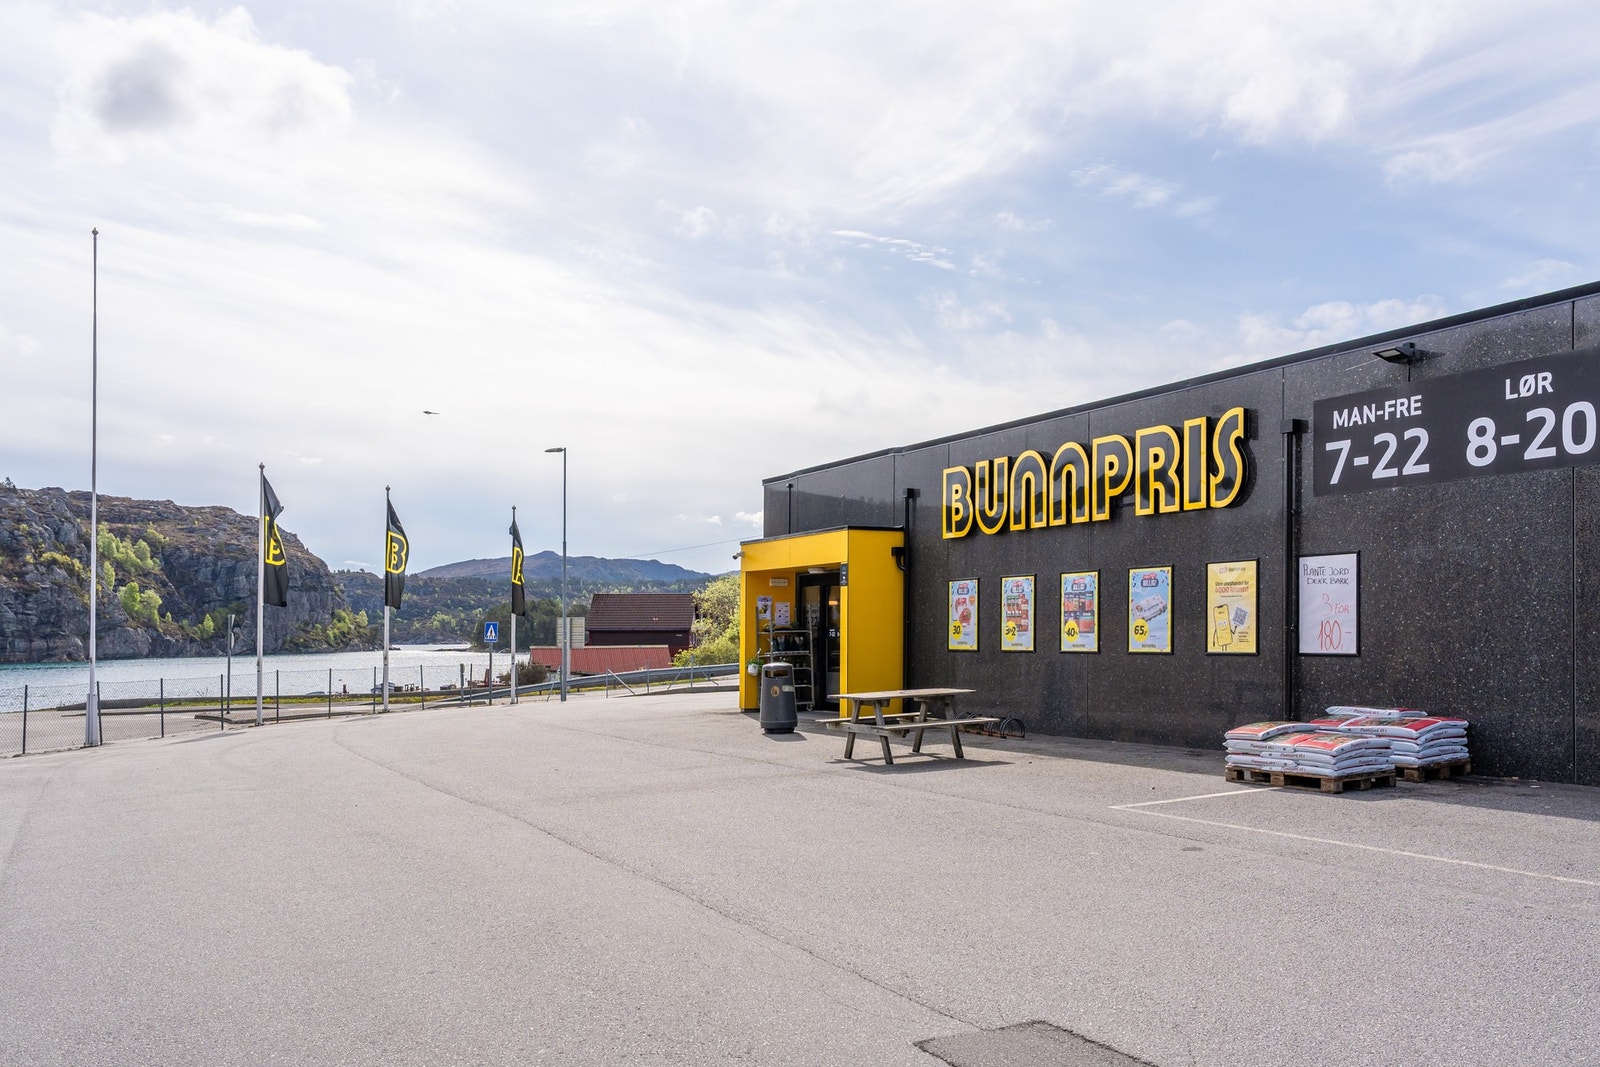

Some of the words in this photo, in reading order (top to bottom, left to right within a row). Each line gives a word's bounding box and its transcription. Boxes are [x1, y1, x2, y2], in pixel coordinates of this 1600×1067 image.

[1505, 371, 1554, 401] LØR
[1332, 395, 1423, 430] MAN-FRE
[1465, 401, 1597, 467] 8-20
[1325, 427, 1430, 485] 7-22
[942, 407, 1246, 540] BUNNPRIS
[1303, 563, 1326, 577] PLANTE
[1306, 577, 1328, 585] DEKK
[1330, 577, 1349, 585] BARK
[1321, 592, 1333, 616] 3
[1334, 602, 1350, 615] FOR
